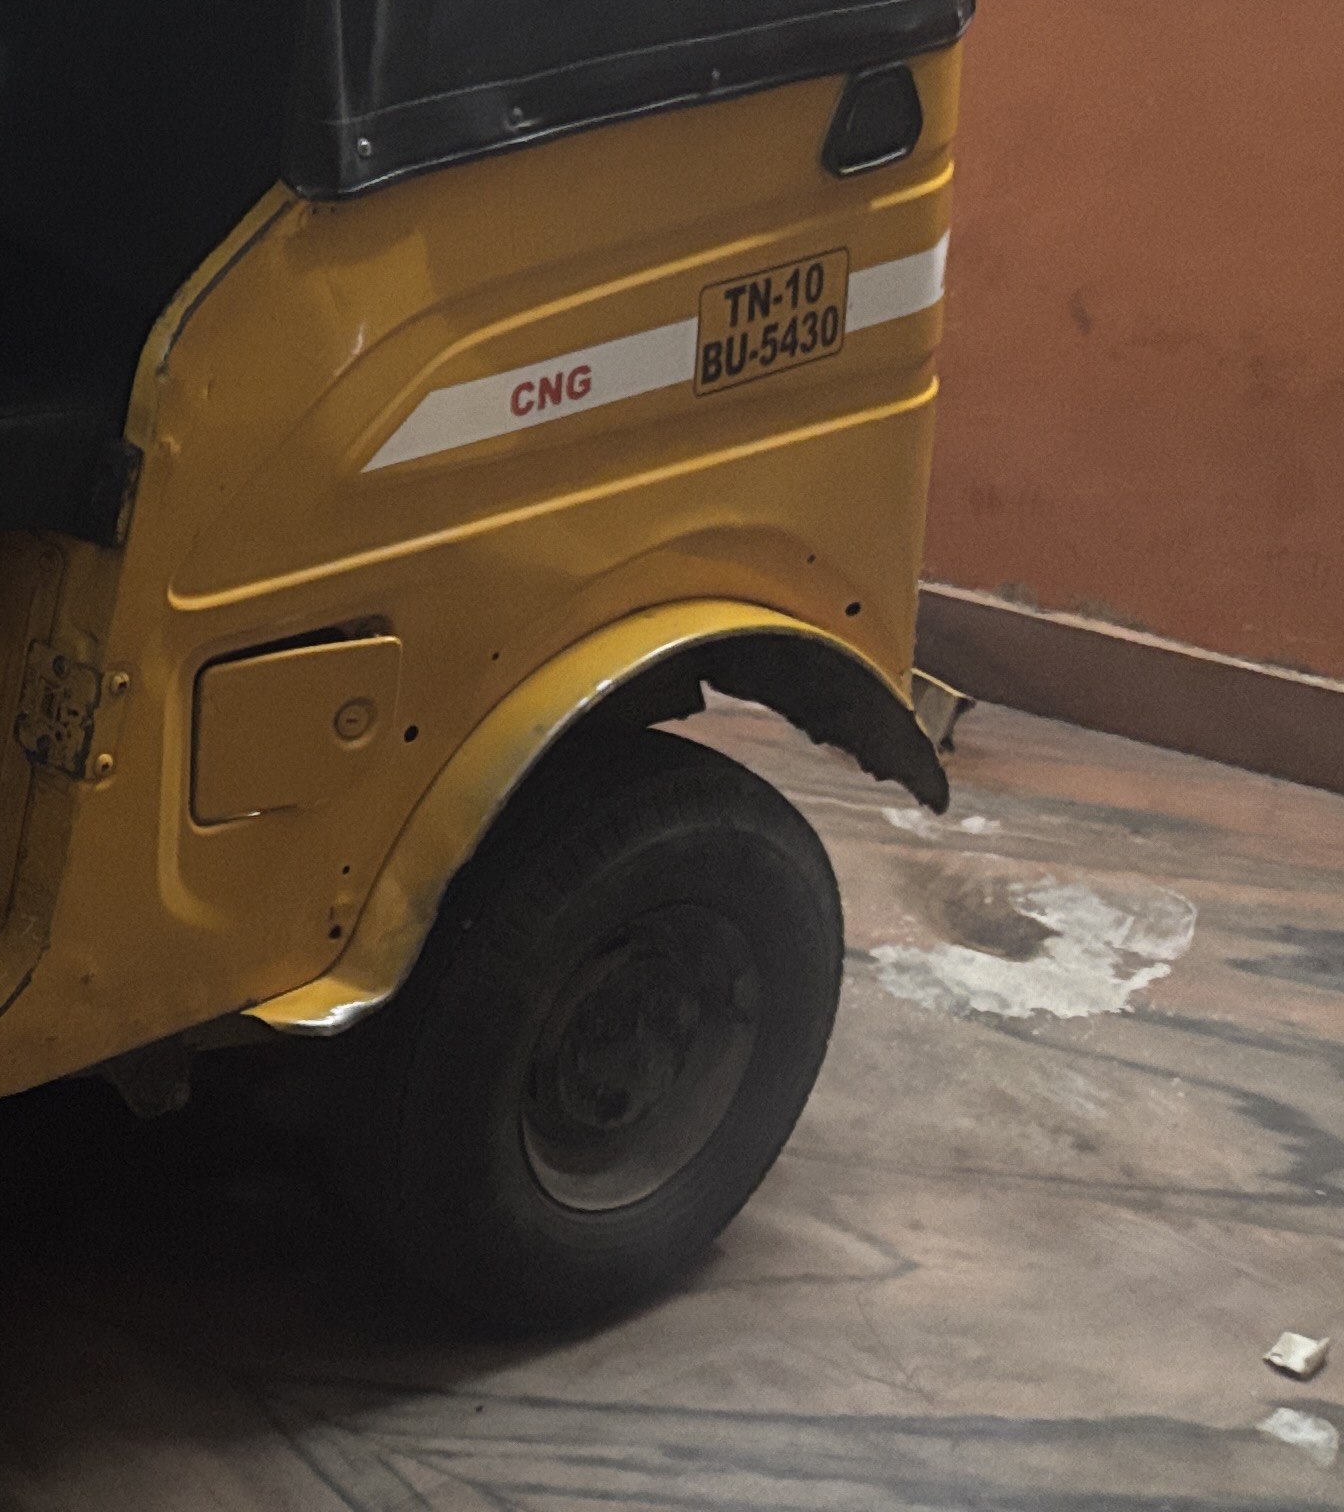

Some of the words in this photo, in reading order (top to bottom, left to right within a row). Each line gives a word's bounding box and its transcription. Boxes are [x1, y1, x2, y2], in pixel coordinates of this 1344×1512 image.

[723, 261, 826, 328] TN-10
[700, 303, 840, 386] BU-5430
[509, 364, 593, 418] CNG
